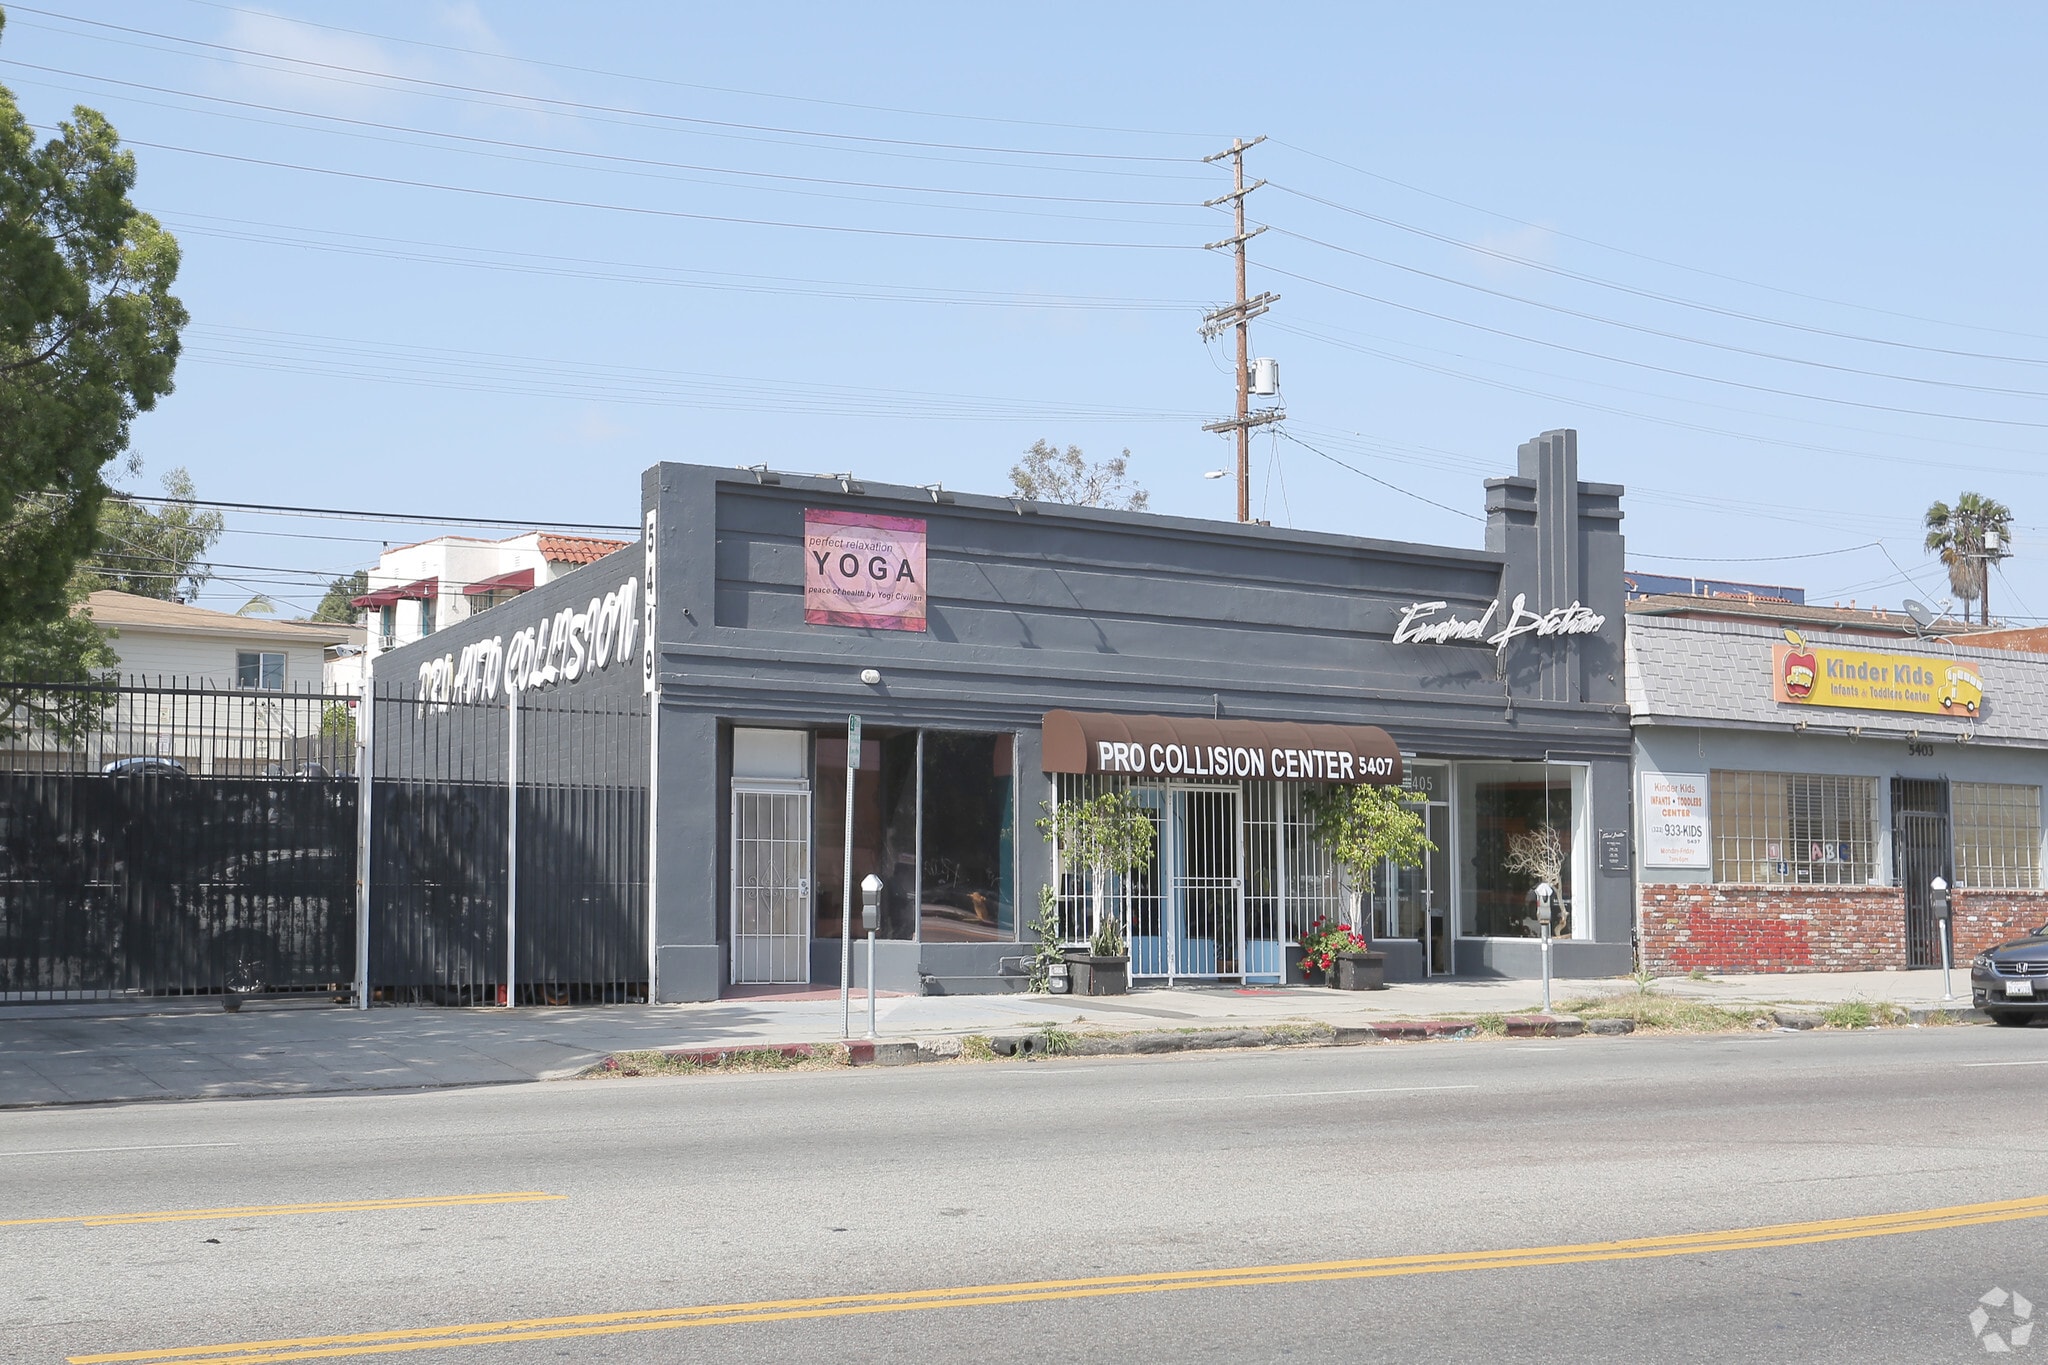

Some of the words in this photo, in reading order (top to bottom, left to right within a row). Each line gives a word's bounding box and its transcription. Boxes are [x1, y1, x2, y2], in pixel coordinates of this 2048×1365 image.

[809, 537, 843, 548] perfect
[846, 541, 893, 553] relaxation
[813, 551, 915, 583] YOGA
[646, 522, 655, 680] 5419
[808, 586, 831, 595] peace
[833, 587, 841, 595] of
[842, 589, 865, 598] health
[866, 591, 876, 599] by
[878, 592, 893, 601] Yogi
[895, 593, 922, 602] Civilian
[1392, 599, 1499, 644] Enamel
[1827, 658, 1888, 682] Kinder
[1894, 664, 1935, 686] Kids
[1831, 683, 1859, 697] Infants
[1870, 686, 1902, 700] Toddlers
[1905, 689, 1930, 702] Center
[1908, 744, 1934, 757] 5403
[1098, 741, 1146, 772] PRO
[1149, 744, 1265, 776] COLLISION
[1271, 749, 1354, 779] CENTER
[1359, 757, 1393, 776] 5407
[1654, 783, 1678, 793] Kinder
[1680, 784, 1696, 793] Kids
[1651, 796, 1671, 806] INFANTS
[1677, 797, 1702, 807] TODDLERS
[1662, 809, 1691, 817] CENTER
[1664, 824, 1702, 837] 933-KIDS
